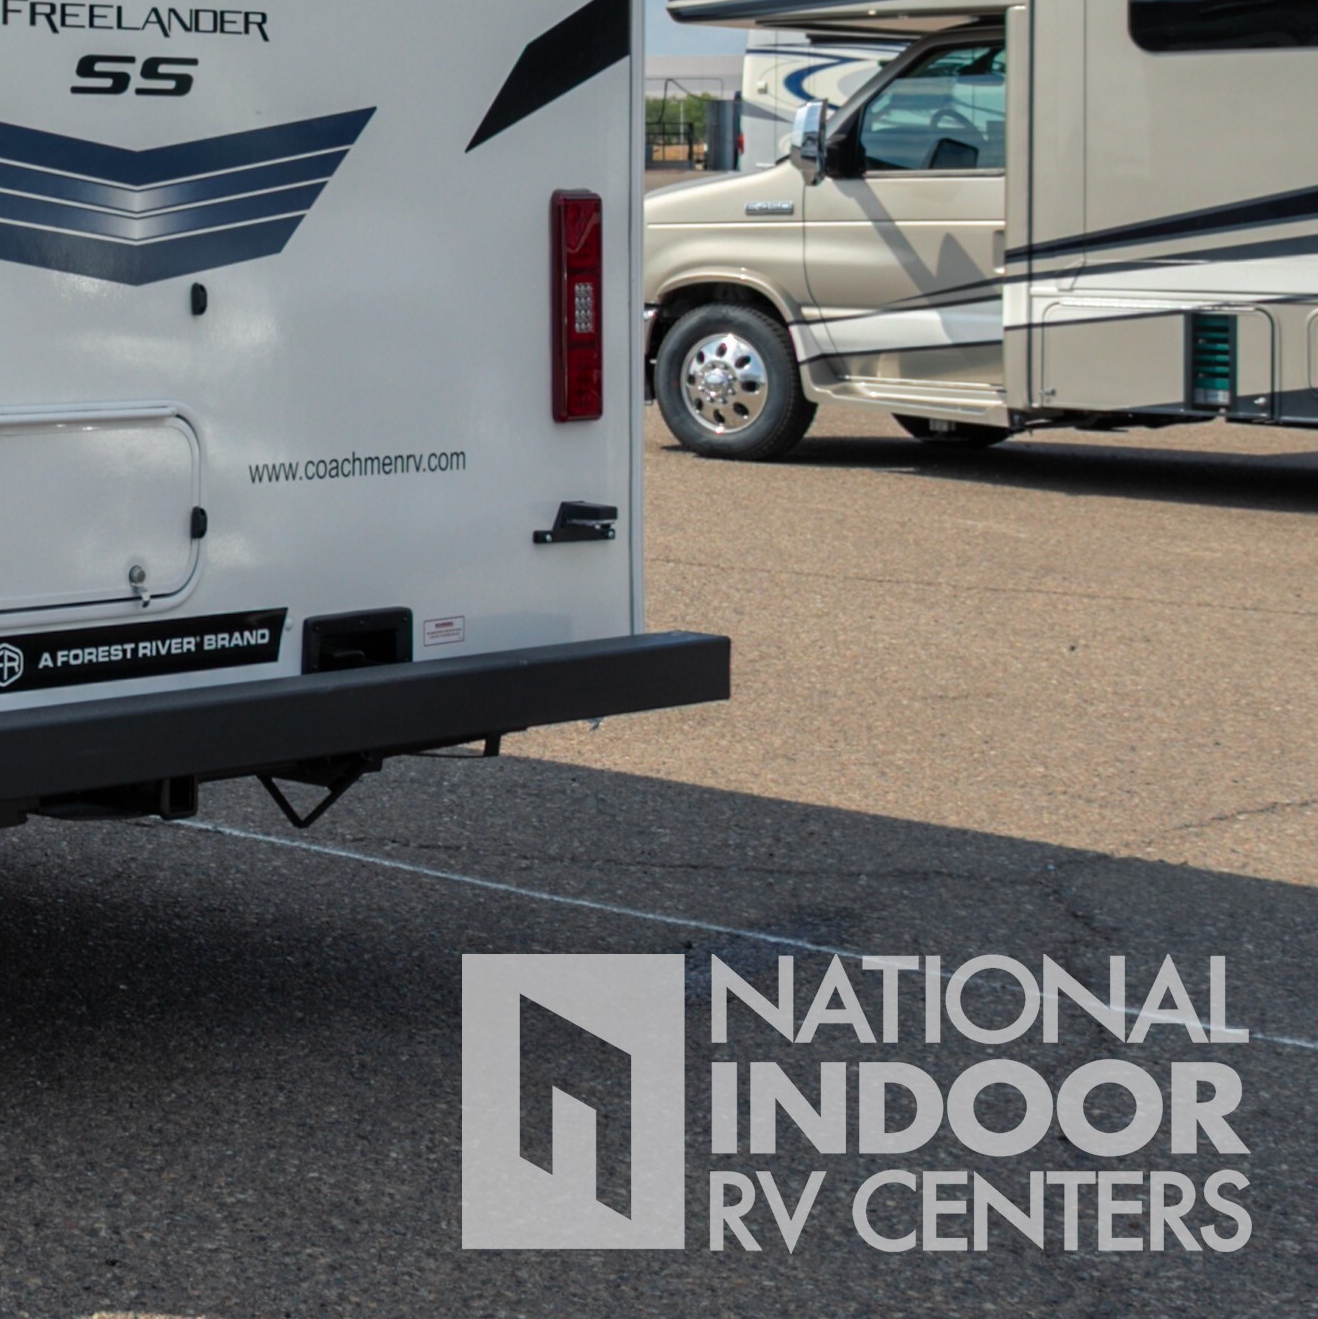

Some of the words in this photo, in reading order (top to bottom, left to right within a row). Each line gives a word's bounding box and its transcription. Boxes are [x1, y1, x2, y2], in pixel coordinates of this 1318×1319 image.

[70, 54, 200, 97] SS
[249, 451, 467, 485] www.coachmenrv.com
[38, 652, 54, 669] A
[57, 644, 135, 667] FOREST
[203, 629, 270, 651] BRAND
